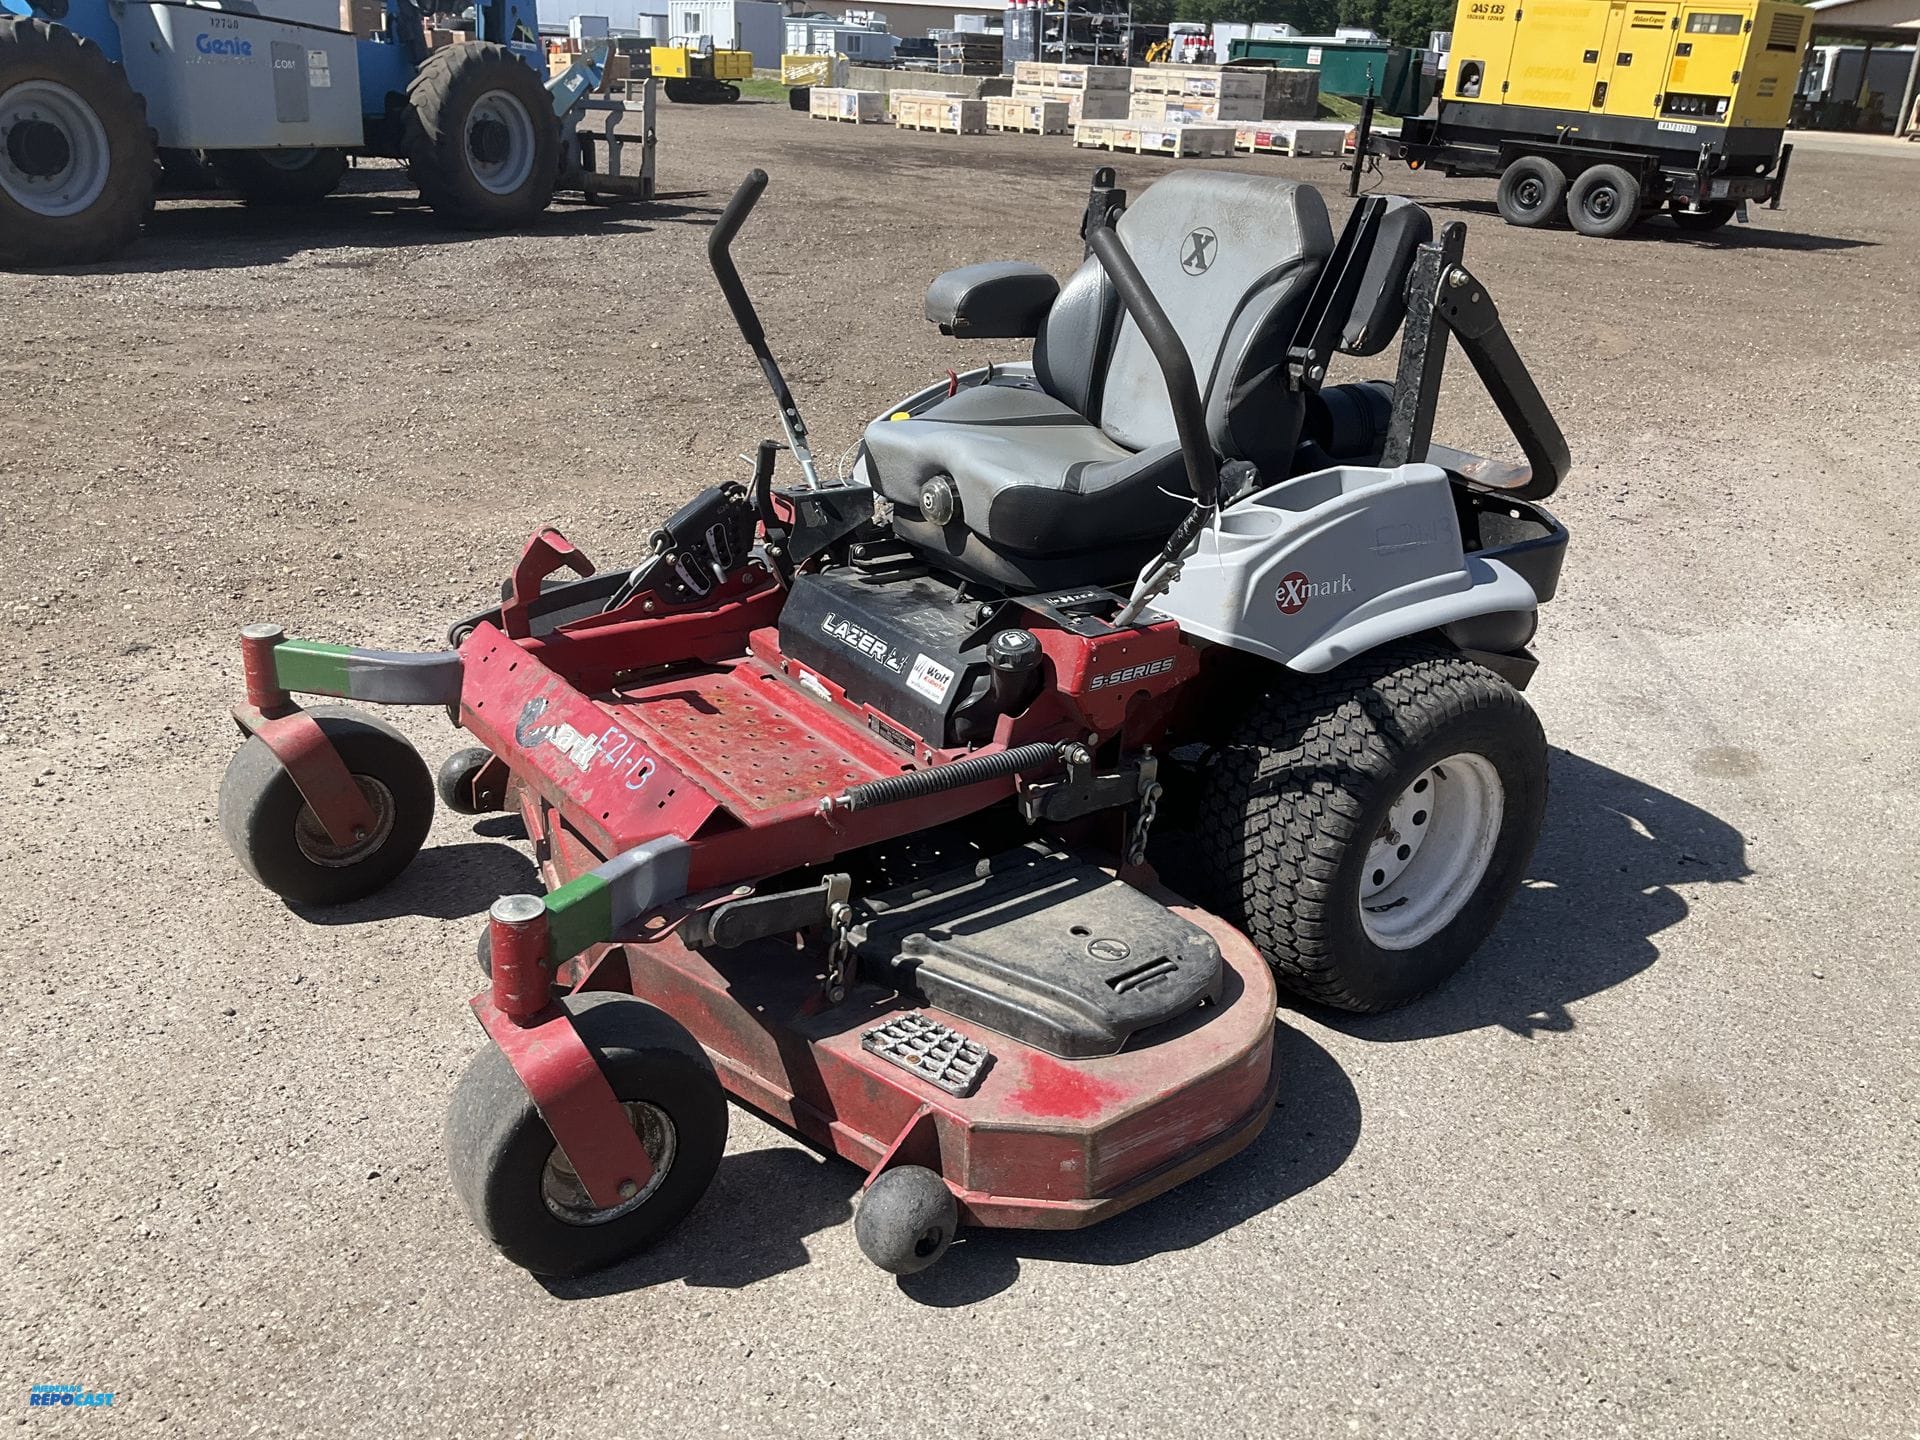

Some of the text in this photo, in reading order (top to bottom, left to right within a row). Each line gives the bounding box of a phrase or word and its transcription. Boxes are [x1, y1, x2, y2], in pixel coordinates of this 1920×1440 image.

[1471, 3, 1490, 14] QAS
[196, 33, 252, 56] Genie
[821, 612, 889, 664] LAZER
[927, 666, 950, 684] Wolf
[1092, 657, 1174, 690] S-SERIES
[595, 726, 656, 790] E21-13
